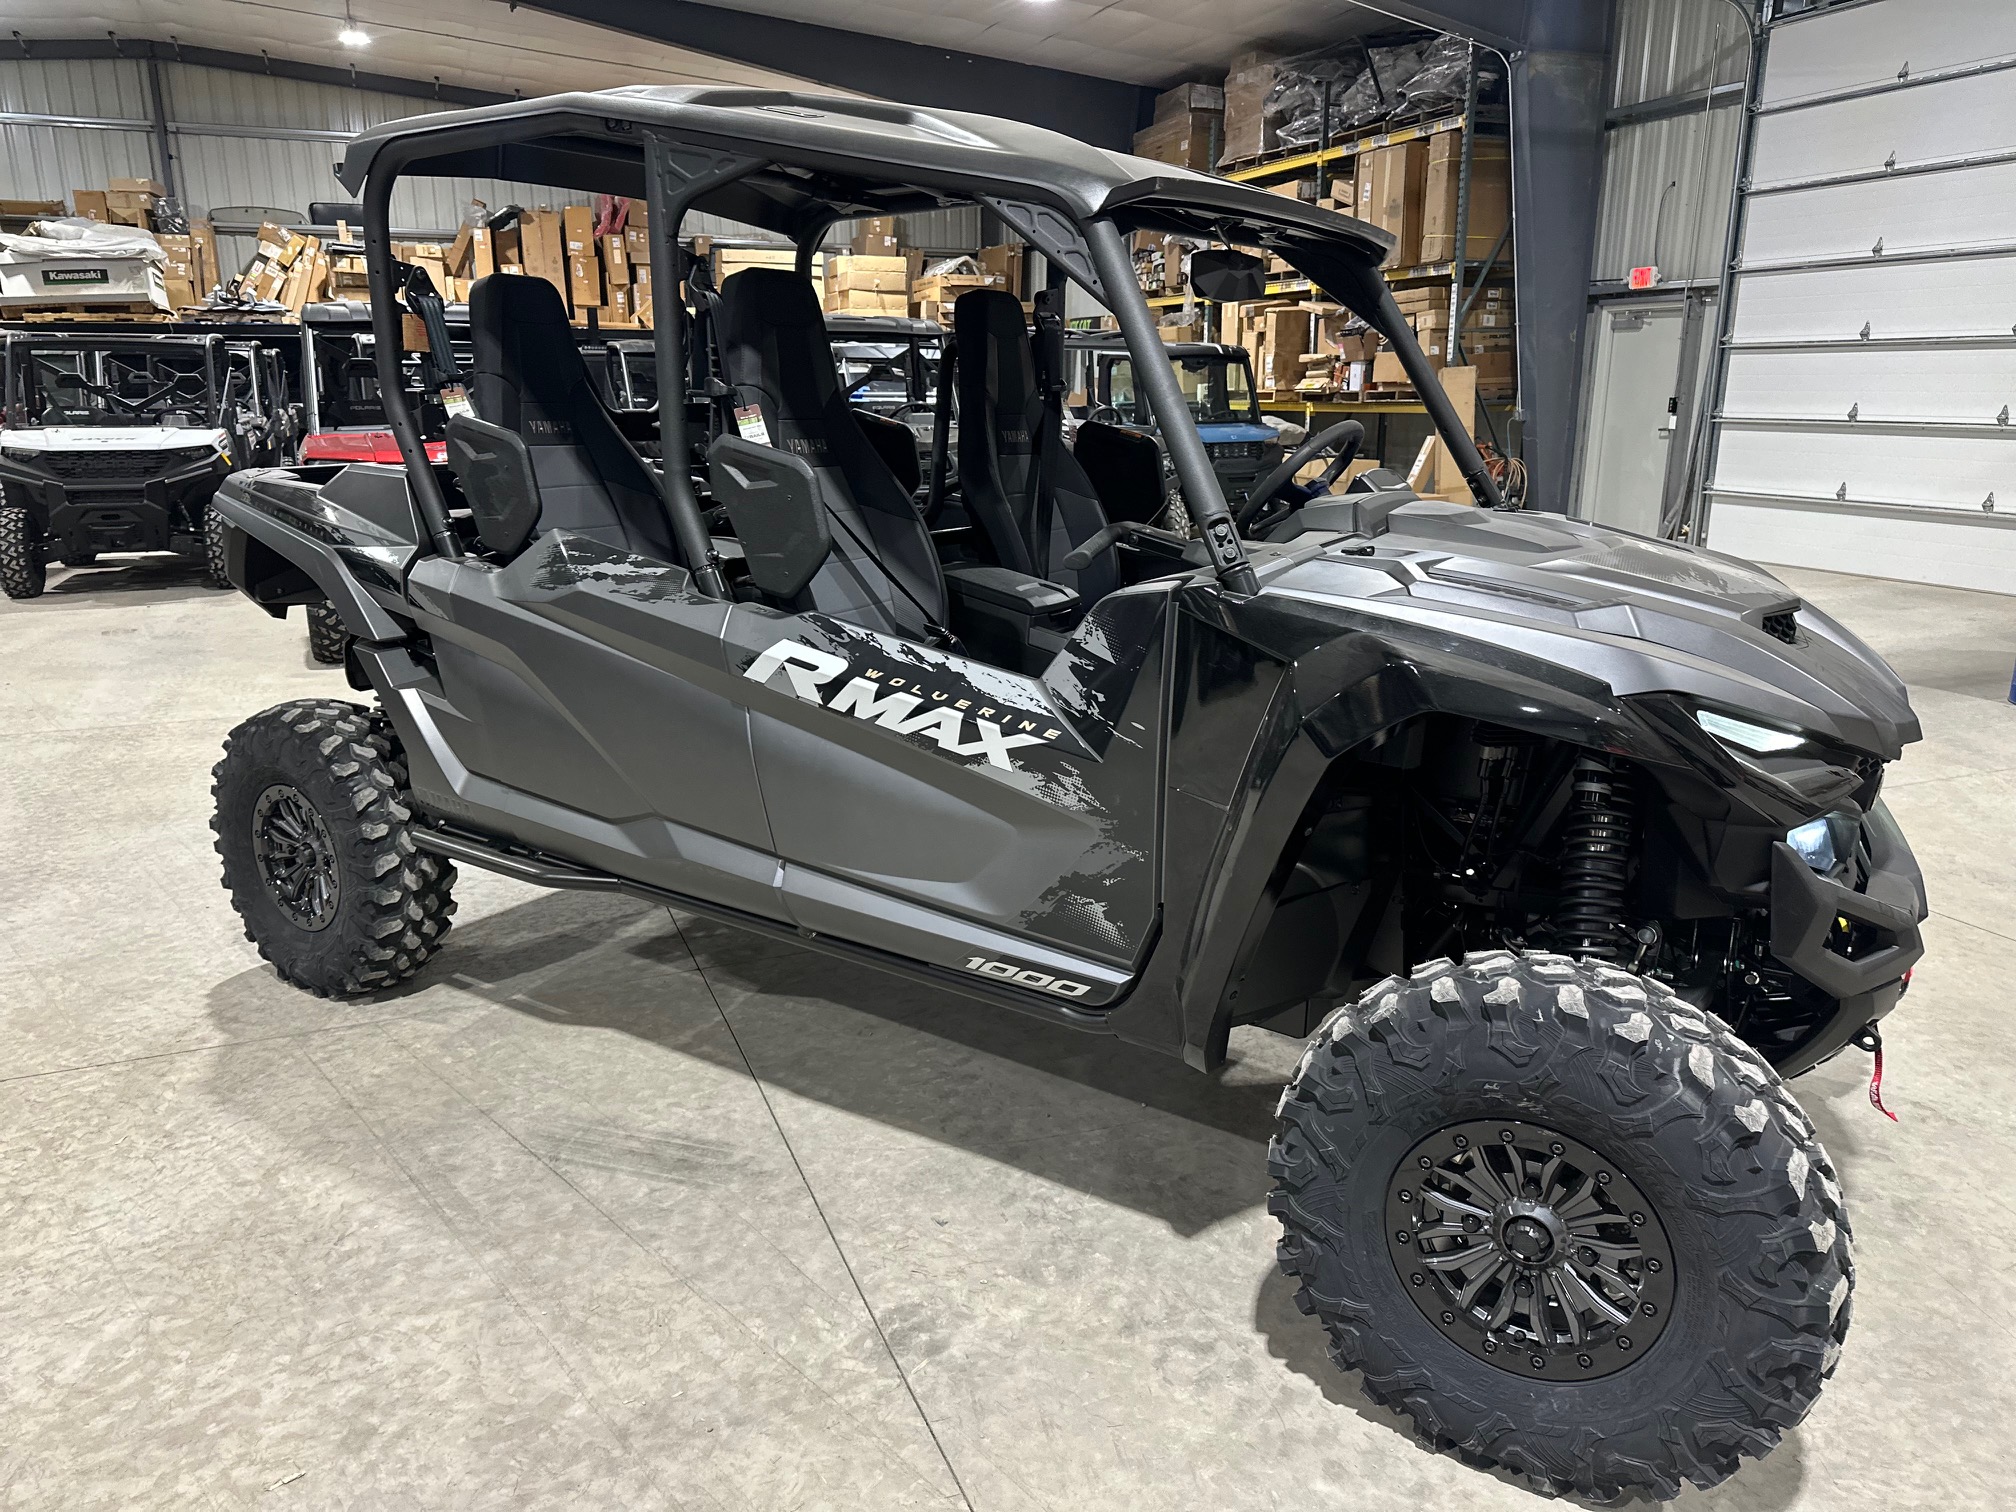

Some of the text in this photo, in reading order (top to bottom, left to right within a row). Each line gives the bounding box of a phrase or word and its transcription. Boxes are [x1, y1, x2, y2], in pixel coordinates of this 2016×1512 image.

[49, 271, 101, 281] Kawasaki
[786, 439, 828, 454] YAMAHA
[1001, 430, 1030, 443] YAMAHA
[743, 638, 1050, 773] RMAX
[864, 667, 1063, 741] WOLVERINE
[965, 956, 1092, 996] 1000
